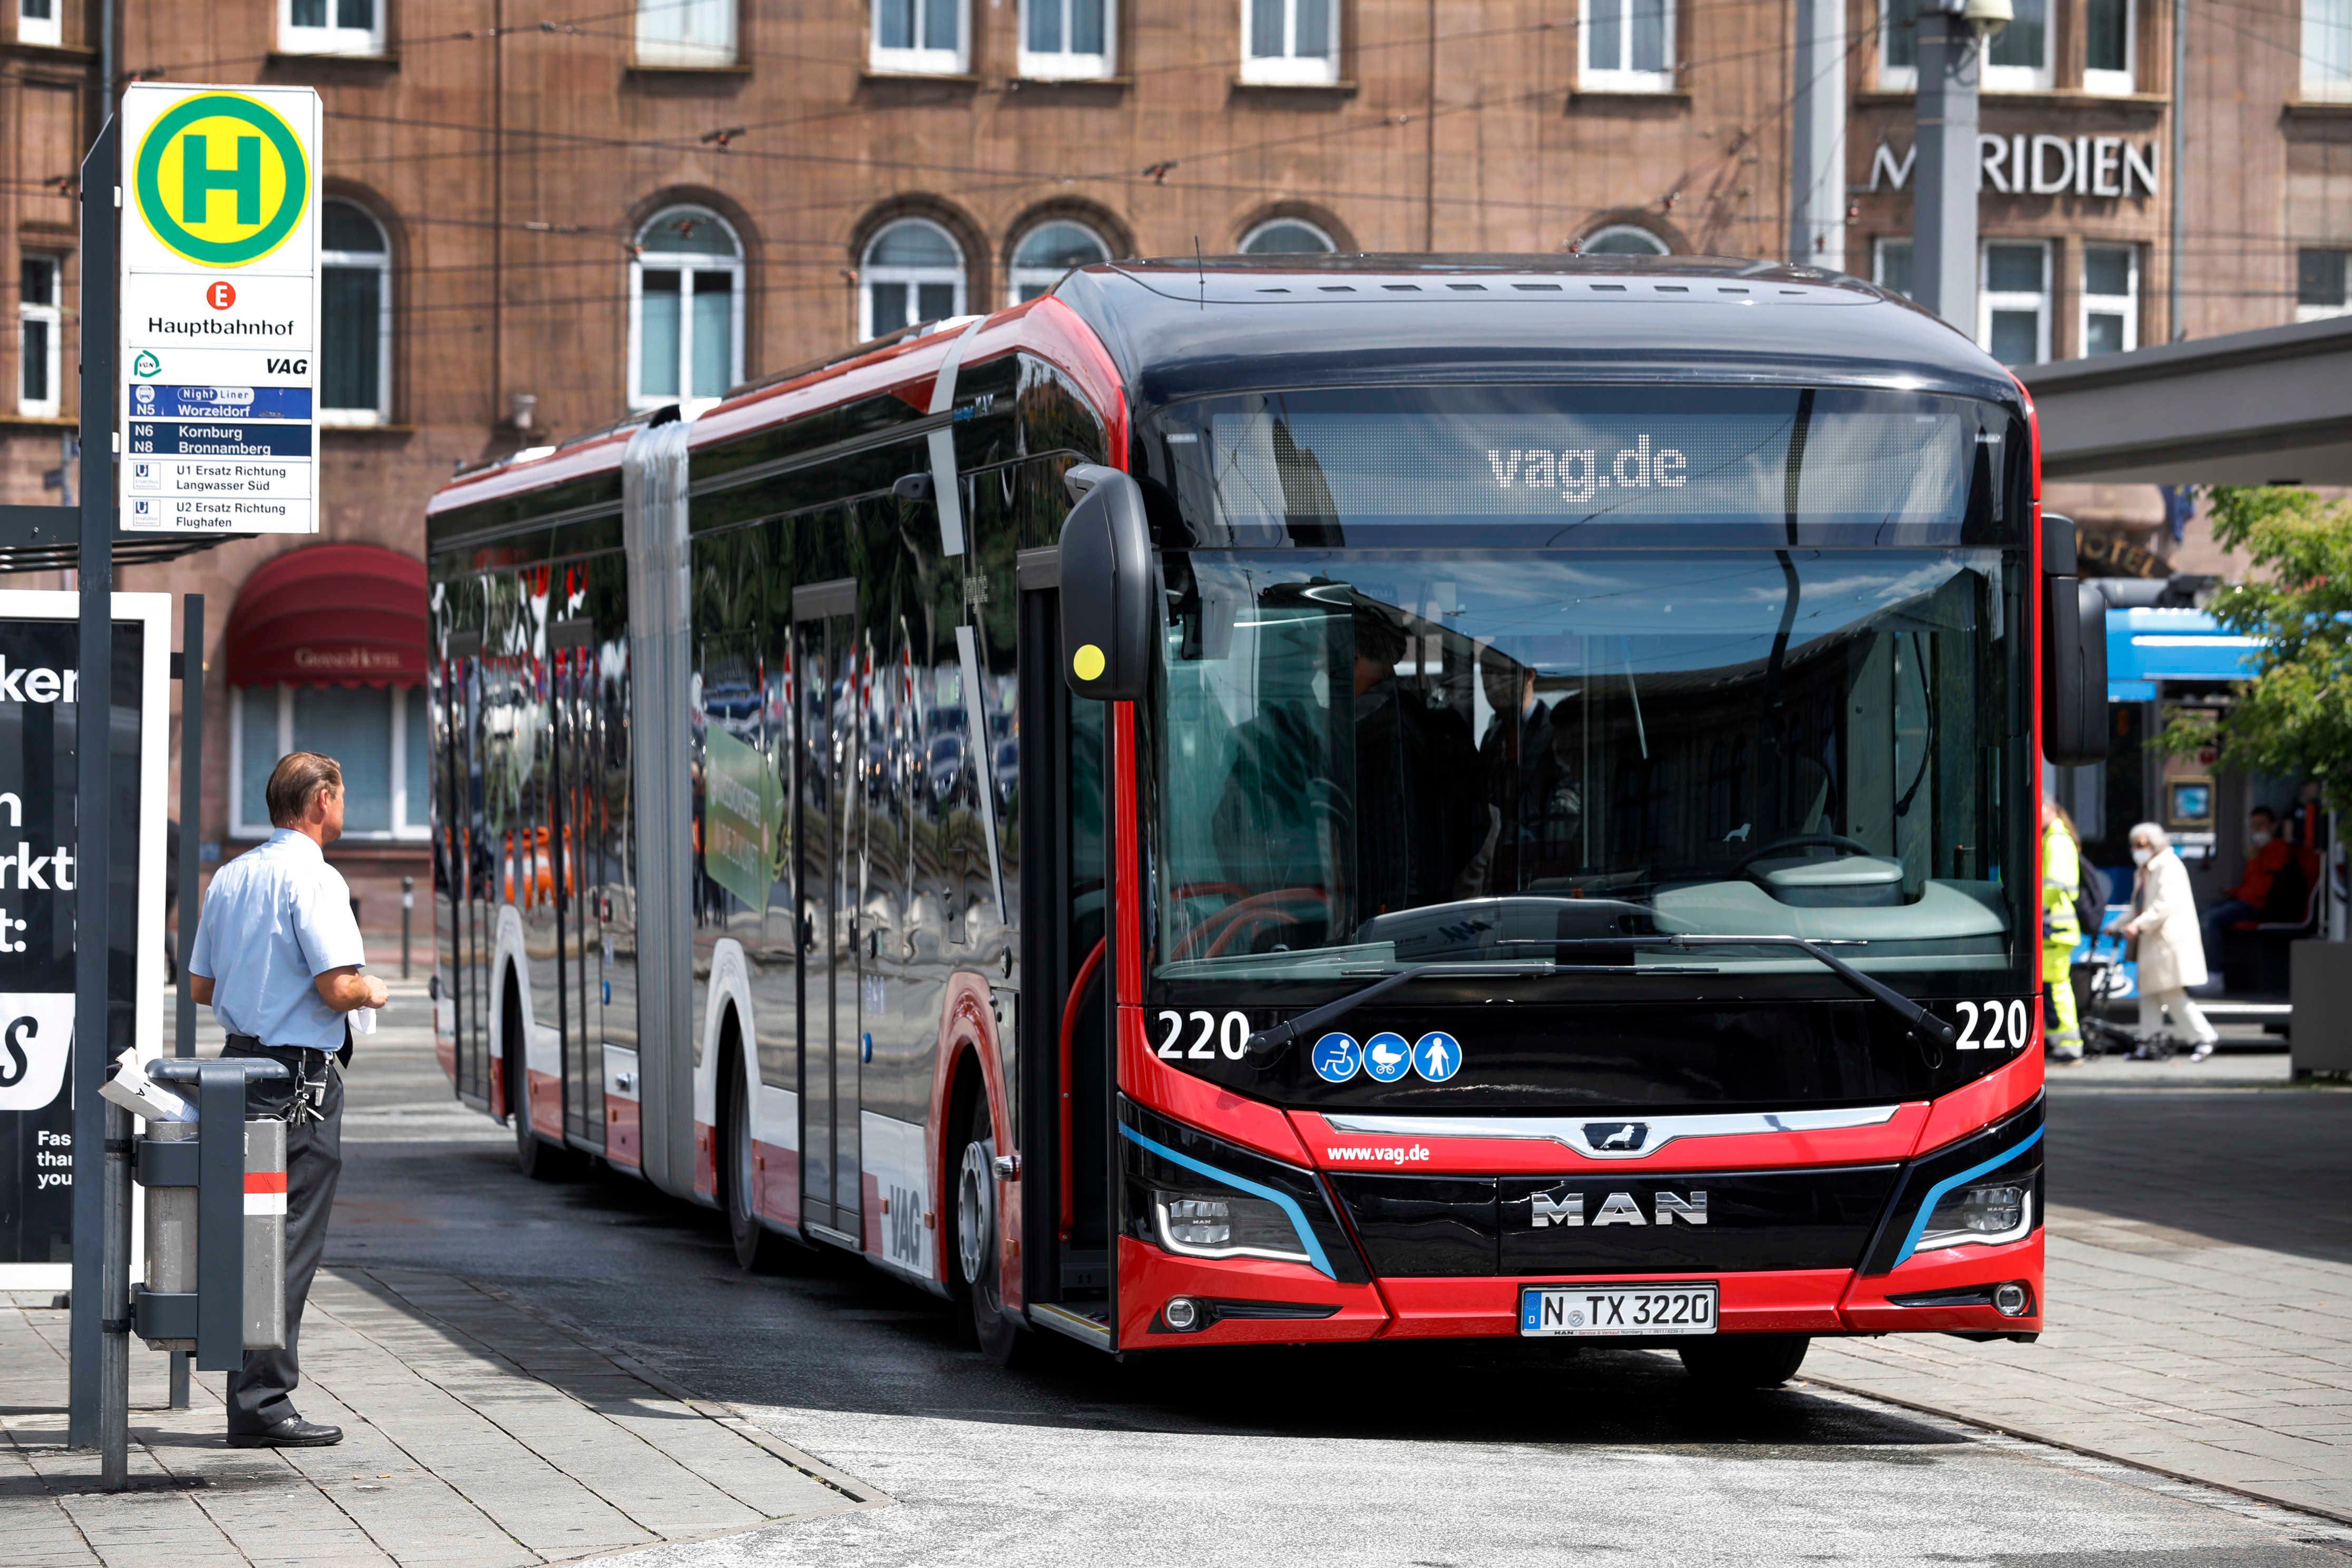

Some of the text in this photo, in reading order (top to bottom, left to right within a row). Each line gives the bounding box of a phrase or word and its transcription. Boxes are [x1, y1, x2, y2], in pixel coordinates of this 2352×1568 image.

[1869, 133, 2159, 197] MRIDIEN
[183, 134, 260, 225] H
[215, 285, 228, 307] E
[149, 317, 295, 337] Hauptbahnhof
[267, 359, 308, 375] VAG
[183, 388, 249, 401] Night Liner
[136, 404, 250, 417] N5 Worzeldorf
[135, 425, 242, 442] N6 Kornburg
[134, 441, 271, 456] N8 Bronnamberg
[177, 465, 286, 478] U1 Ersatz Richtung
[1488, 434, 1686, 502] vag.de
[177, 480, 270, 492] Langwasser Süd
[177, 502, 286, 515] U2 Ersatz Richtung
[177, 517, 232, 528] Flughafen
[1955, 999, 2027, 1050] 220
[1158, 1011, 1250, 1060] 220
[1327, 1144, 1429, 1165] www.vag.de
[1531, 1191, 1708, 1227] MAN
[890, 1184, 920, 1266] VAG
[1528, 1315, 1535, 1324] D
[1544, 1294, 1709, 1325] N TX 3220
